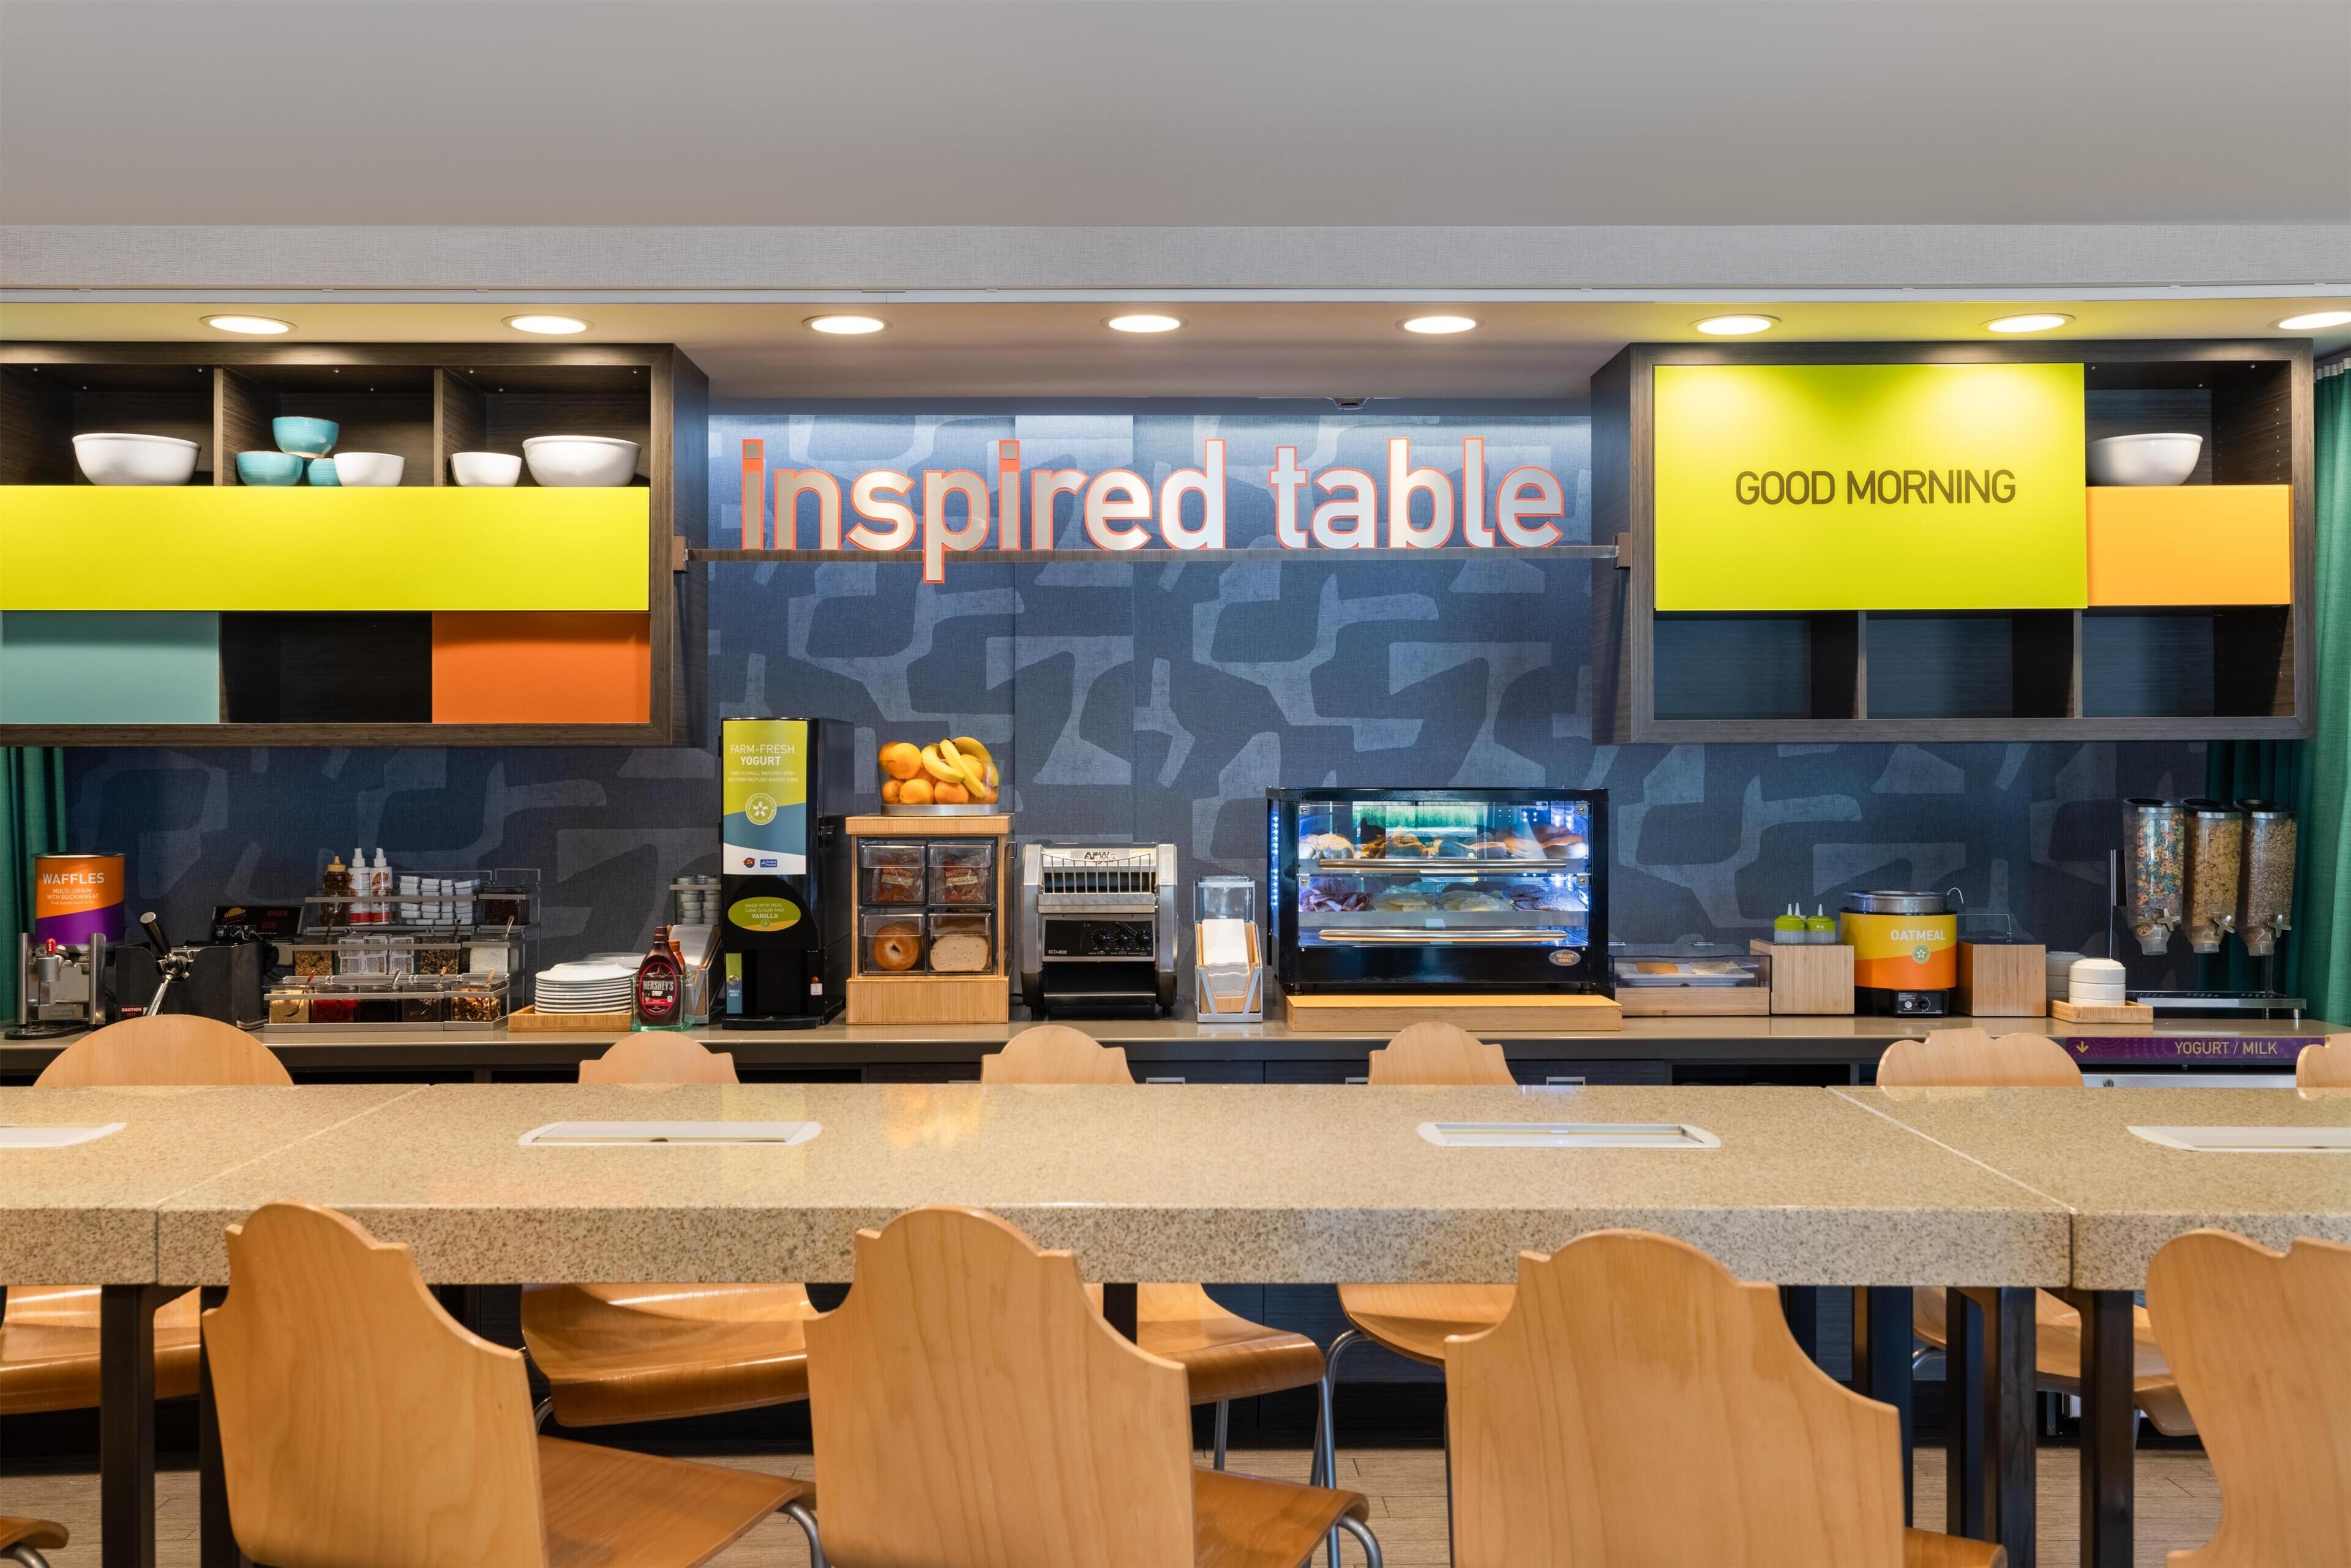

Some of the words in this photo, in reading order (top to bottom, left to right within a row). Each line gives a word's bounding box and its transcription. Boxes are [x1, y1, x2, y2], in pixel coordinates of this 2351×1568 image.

[1735, 470, 1836, 505] GOOD
[1847, 469, 2017, 505] MORNING
[741, 437, 1226, 583] inspired
[1269, 436, 1565, 550] table
[730, 744, 795, 754] FARM-FRESH
[740, 756, 782, 765] YOGURT
[42, 872, 105, 885] WAFFLES
[1890, 929, 1946, 941] OATMEAL
[643, 981, 674, 991] HERSHEY'S
[2174, 1041, 2230, 1054] YOGURT
[2233, 1041, 2238, 1054] /
[2243, 1041, 2278, 1054] MILK
